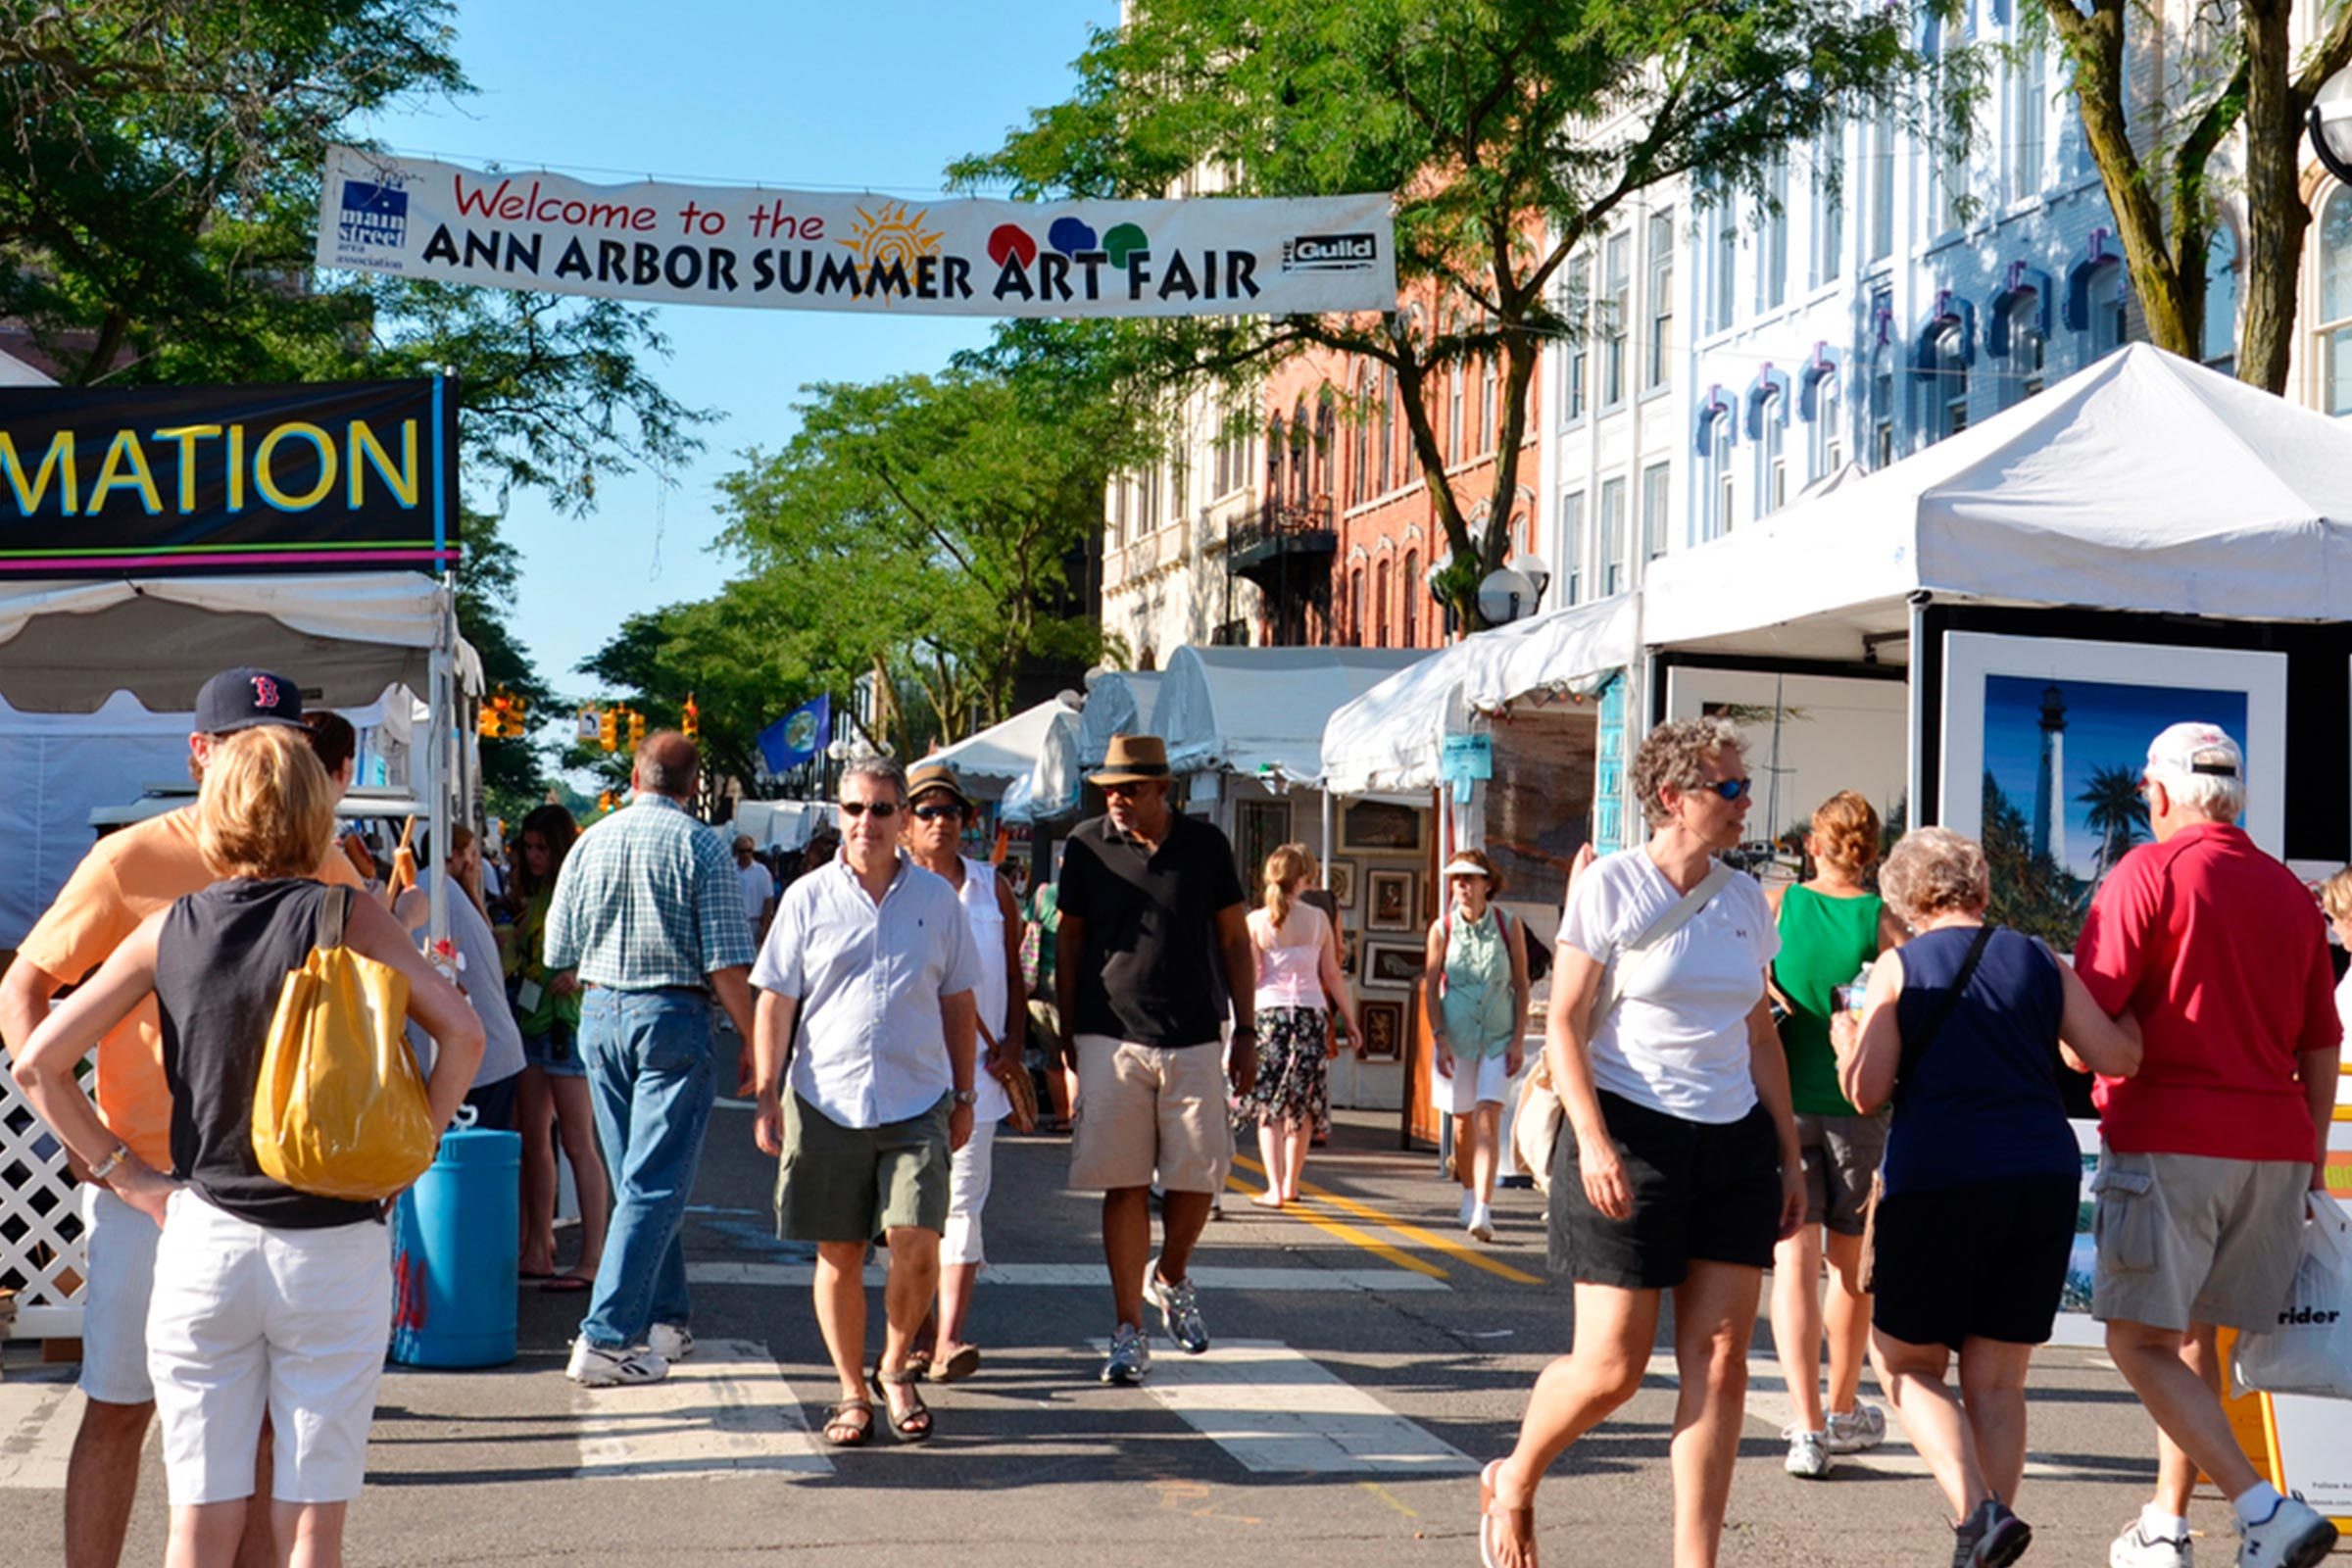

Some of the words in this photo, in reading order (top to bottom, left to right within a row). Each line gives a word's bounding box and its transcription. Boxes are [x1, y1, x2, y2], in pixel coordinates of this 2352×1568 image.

[454, 172, 657, 231] Welcome
[677, 200, 726, 237] to
[749, 199, 825, 241] the
[340, 209, 407, 230] main
[337, 224, 406, 249] street
[421, 222, 542, 275] ANN
[554, 235, 740, 293] ARBOR
[752, 247, 974, 300] SUMMER
[992, 249, 1109, 302] ART
[1126, 249, 1261, 301] FAIR
[1296, 239, 1373, 261] Guild
[0, 419, 418, 516] MATION
[2277, 1304, 2340, 1325] rider
